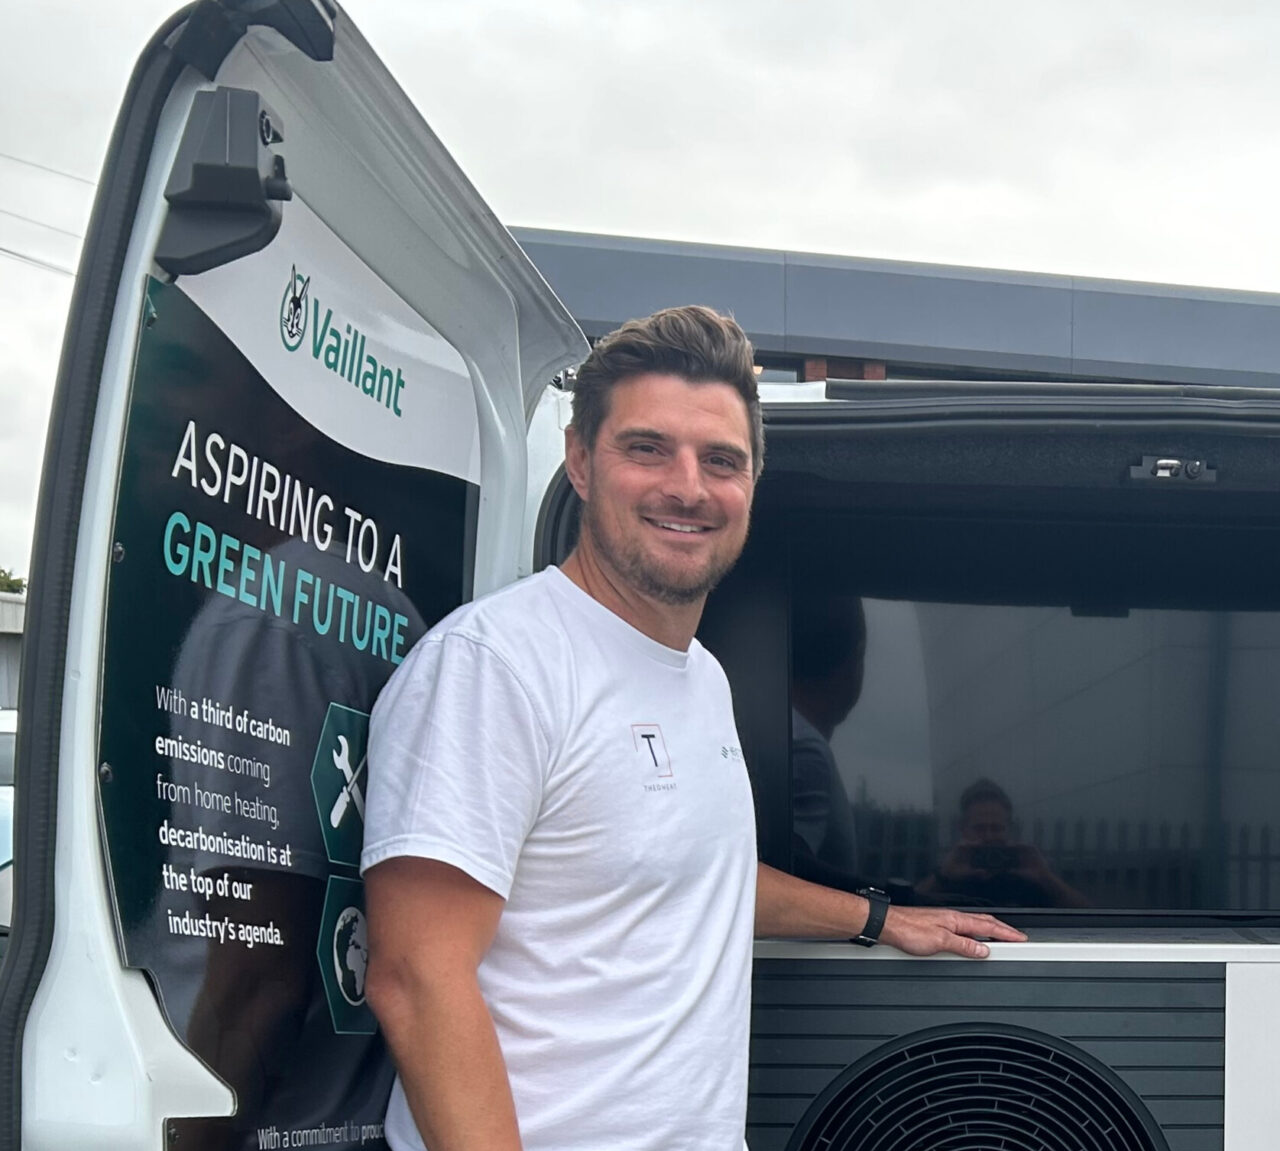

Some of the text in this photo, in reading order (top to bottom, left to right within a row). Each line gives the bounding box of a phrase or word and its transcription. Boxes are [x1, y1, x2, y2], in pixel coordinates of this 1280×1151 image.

[313, 298, 405, 417] Vaillant
[171, 420, 403, 588] ASPIRING TO A
[163, 512, 408, 665] GREEN FUTURE
[156, 685, 290, 746] With a third of carbon
[155, 735, 270, 788] emissions coming
[156, 773, 279, 829] from home heating,
[159, 820, 291, 866] decarbonisation is at
[162, 864, 252, 900] the top of our
[168, 909, 283, 948] industry's agenda.
[257, 1126, 280, 1150] With
[283, 1132, 289, 1148] a
[291, 1122, 348, 1147] commitment
[351, 1121, 361, 1141] to
